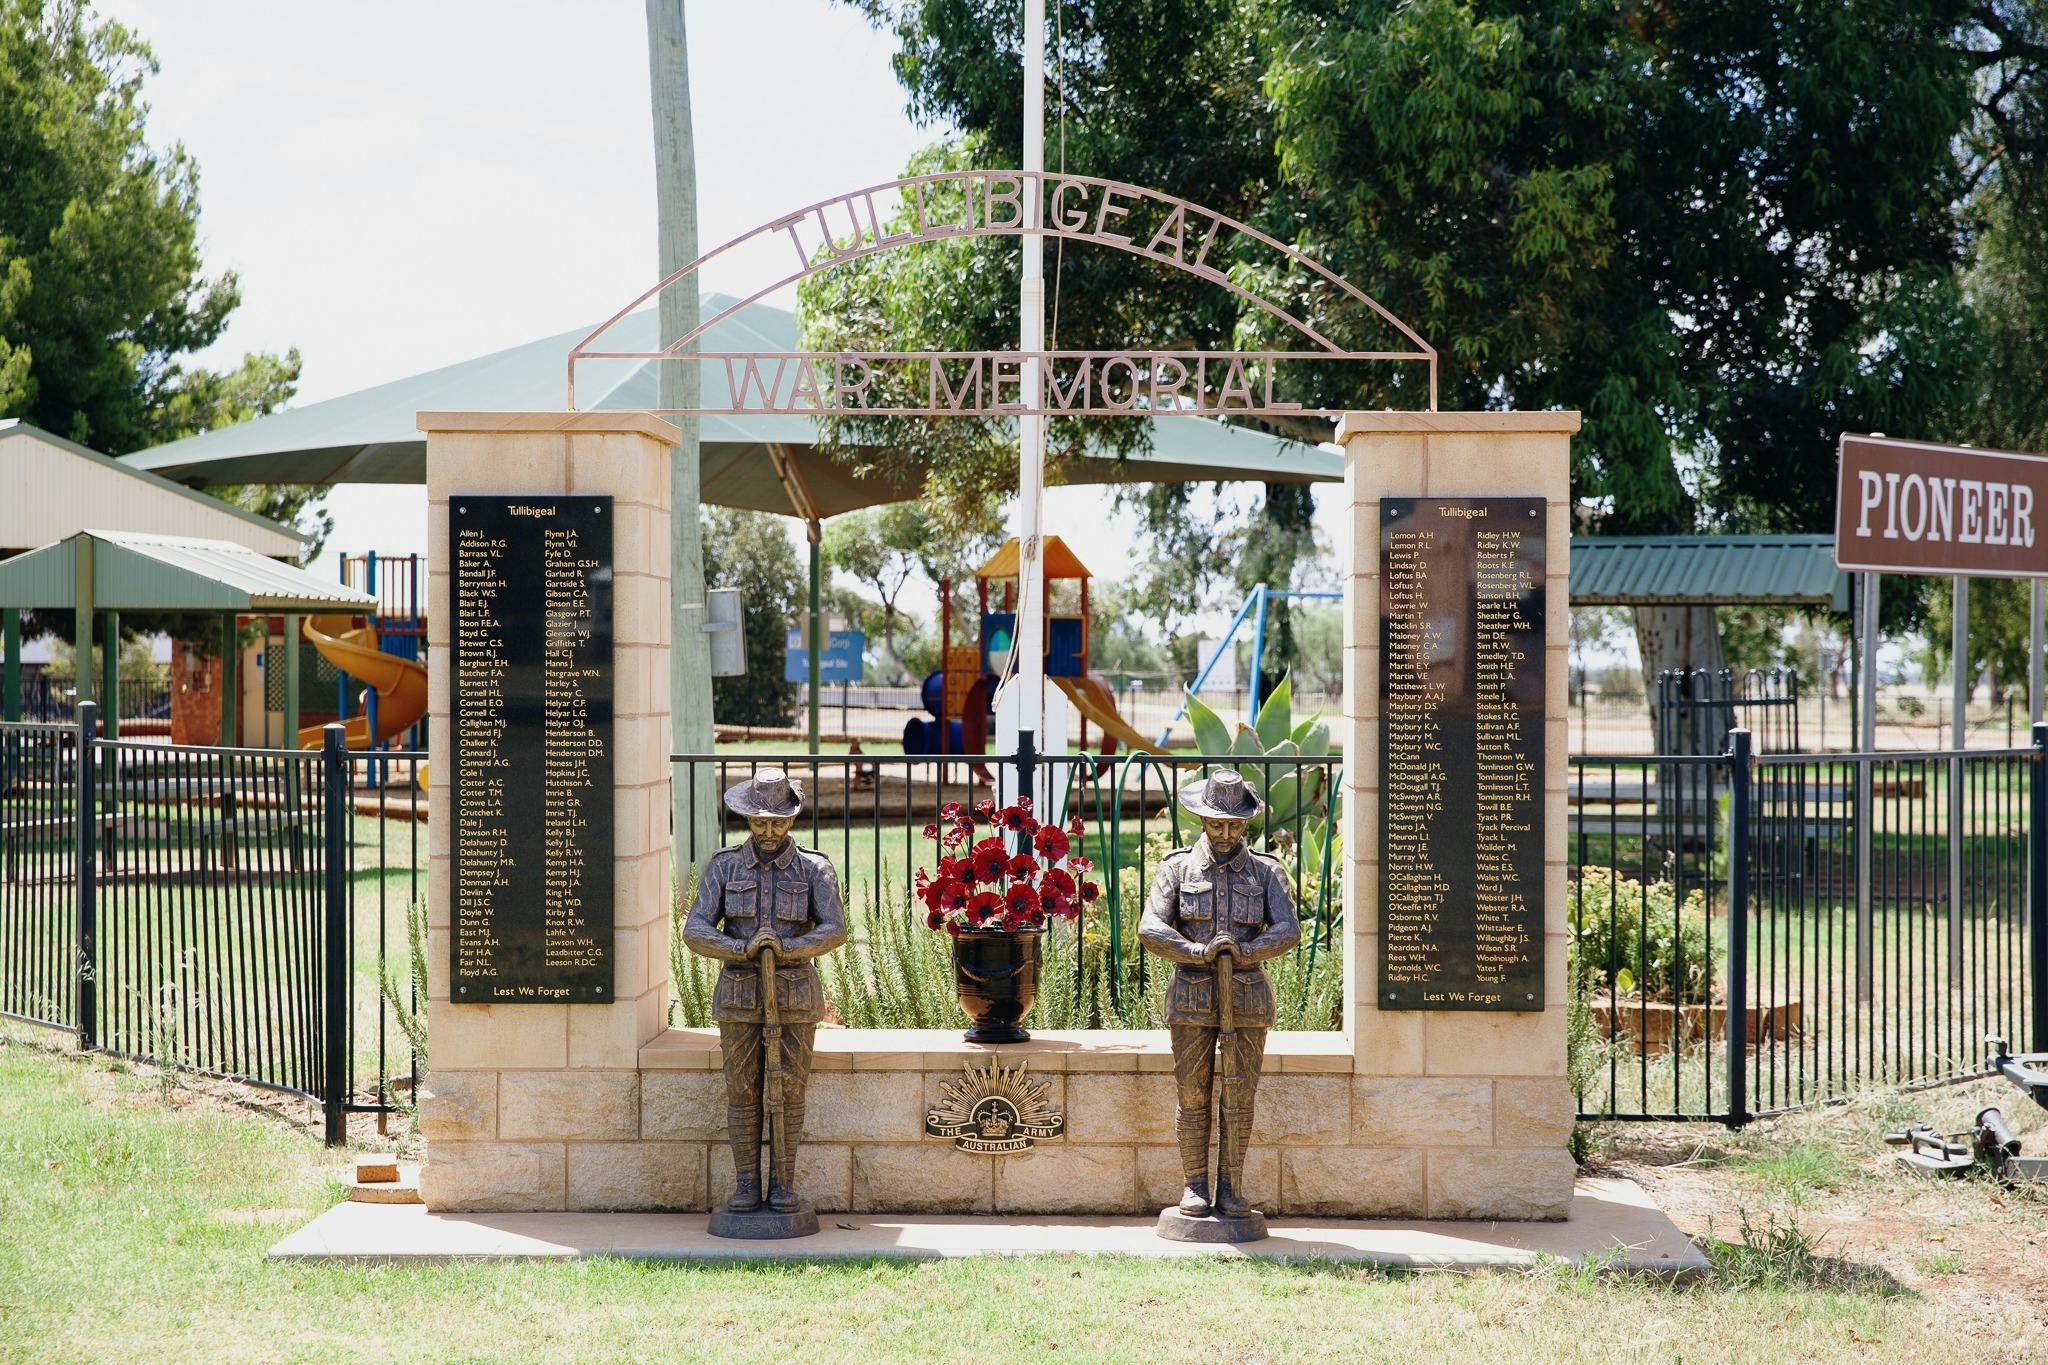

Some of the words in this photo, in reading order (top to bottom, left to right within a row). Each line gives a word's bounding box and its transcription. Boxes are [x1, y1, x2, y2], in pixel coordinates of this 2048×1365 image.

[772, 174, 1228, 282] TULLIBIGEAL
[724, 356, 871, 411] WAR
[930, 356, 1302, 411] MEMORIAL
[508, 505, 556, 518] Tullibigeal
[1438, 507, 1488, 519] Tullibigeal
[1856, 470, 2035, 548] PIONEER
[491, 539, 507, 548] R.G.
[1418, 541, 1432, 549] R.L.
[1477, 541, 1500, 551] Ridley
[1502, 541, 1520, 549] K.W.
[459, 549, 488, 557] Barrass
[545, 550, 562, 559] Fyfe
[459, 559, 481, 567] Baker
[545, 560, 576, 568] Graham
[545, 569, 575, 578] Garland
[459, 579, 497, 589] Berryman
[459, 589, 479, 597] Black
[481, 589, 497, 597] W.S.
[1477, 611, 1510, 620] Sheather
[1512, 611, 1522, 620] G.
[459, 619, 479, 627] Boon
[459, 639, 487, 647] Brewer
[489, 639, 504, 647] C.S.
[1477, 642, 1491, 650] Sim
[1492, 642, 1510, 650] R.W.
[1476, 652, 1509, 661] Smedley
[1511, 652, 1525, 660] T.D.
[545, 659, 568, 667] Hanns
[1389, 662, 1414, 670] Martin
[1416, 662, 1430, 670] E.Y.
[459, 669, 489, 677] Butcher
[491, 669, 505, 677] F.A.
[545, 669, 580, 679] Hargrave
[582, 669, 600, 677] W.N.
[1477, 672, 1498, 680] Smith
[1500, 672, 1515, 680] L.A.
[459, 689, 487, 697] Cornell
[488, 689, 503, 697] H.L.
[545, 690, 573, 699] Harvey
[1389, 692, 1422, 702] Maybury
[1389, 702, 1422, 712] Maybury
[1424, 702, 1439, 710] D.S.
[1476, 702, 1501, 710] Stokes
[1503, 702, 1519, 710] K.R.
[545, 709, 571, 719] Helyar
[572, 709, 588, 717] L.G.
[1476, 712, 1501, 720] Stokes
[1503, 712, 1519, 720] R.C.
[545, 729, 586, 737] Henderson
[1389, 732, 1422, 742] Maybury
[1476, 732, 1504, 740] Sullivan
[1506, 733, 1522, 741] M.L.
[459, 739, 488, 747] Chalker
[545, 749, 586, 757] Henderson
[588, 749, 604, 757] D.M.
[1389, 752, 1420, 760] McCann
[1477, 762, 1514, 771] Tomlinson
[1515, 763, 1535, 771] G.W.
[545, 769, 576, 778] Hopkins
[577, 769, 590, 779] J.C.
[1389, 772, 1428, 782] McDougall
[1430, 772, 1447, 780] A.G.
[459, 779, 486, 787] Cotter
[488, 779, 504, 787] A.C.
[545, 779, 583, 787] Hutchison
[584, 779, 593, 787] A.
[1476, 783, 1514, 791] Tomlinson
[1515, 783, 1530, 791] L.T.
[459, 798, 486, 807] Crowe
[487, 799, 503, 807] L.A.
[545, 799, 565, 807] Imrie
[566, 799, 582, 807] G.R.
[1388, 802, 1424, 812] McSweyn
[1426, 803, 1443, 811] N.G.
[459, 808, 494, 816] Crutchet
[459, 818, 477, 826] Dale
[545, 819, 571, 827] Ireland
[572, 819, 587, 827] L.H.
[1415, 823, 1428, 832] J.A.
[1476, 823, 1498, 832] Tyack
[1500, 823, 1530, 831] Percival
[545, 829, 563, 838] Kelly
[565, 828, 576, 838] B.J.
[1388, 833, 1418, 841] Meuron
[1419, 833, 1430, 841] L.I.
[1388, 853, 1416, 862] Murray
[1418, 853, 1429, 861] W.
[460, 858, 498, 868] Delahunty
[500, 858, 516, 866] M.R.
[1388, 863, 1413, 871] Norris
[1415, 863, 1434, 871] H.W.
[460, 878, 491, 886] Denman
[493, 878, 509, 886] A.H.
[545, 879, 568, 888] Kemp
[569, 879, 581, 888] J.A.
[1510, 894, 1524, 903] J.H.
[1476, 904, 1509, 912] Webster
[460, 918, 480, 926] Dunn
[481, 918, 490, 926] G.
[567, 918, 584, 926] R.W.
[1388, 923, 1418, 933] Pidgeon
[1420, 924, 1432, 933] A.J.
[1388, 933, 1412, 941] Pierce
[1388, 943, 1420, 951] Reardon
[1476, 944, 1502, 952] Wilson
[1504, 944, 1518, 952] S.R.
[587, 948, 603, 956] C.G.
[494, 987, 514, 996] Lest
[518, 987, 535, 996] We
[538, 987, 570, 998] Forget
[1424, 992, 1444, 1002] Lest
[1448, 992, 1465, 1002] We
[1468, 992, 1502, 1004] Forget
[940, 1127, 962, 1136] THE
[962, 1140, 1027, 1151] AUSTRALIAN
[1022, 1127, 1054, 1137] ARMY
